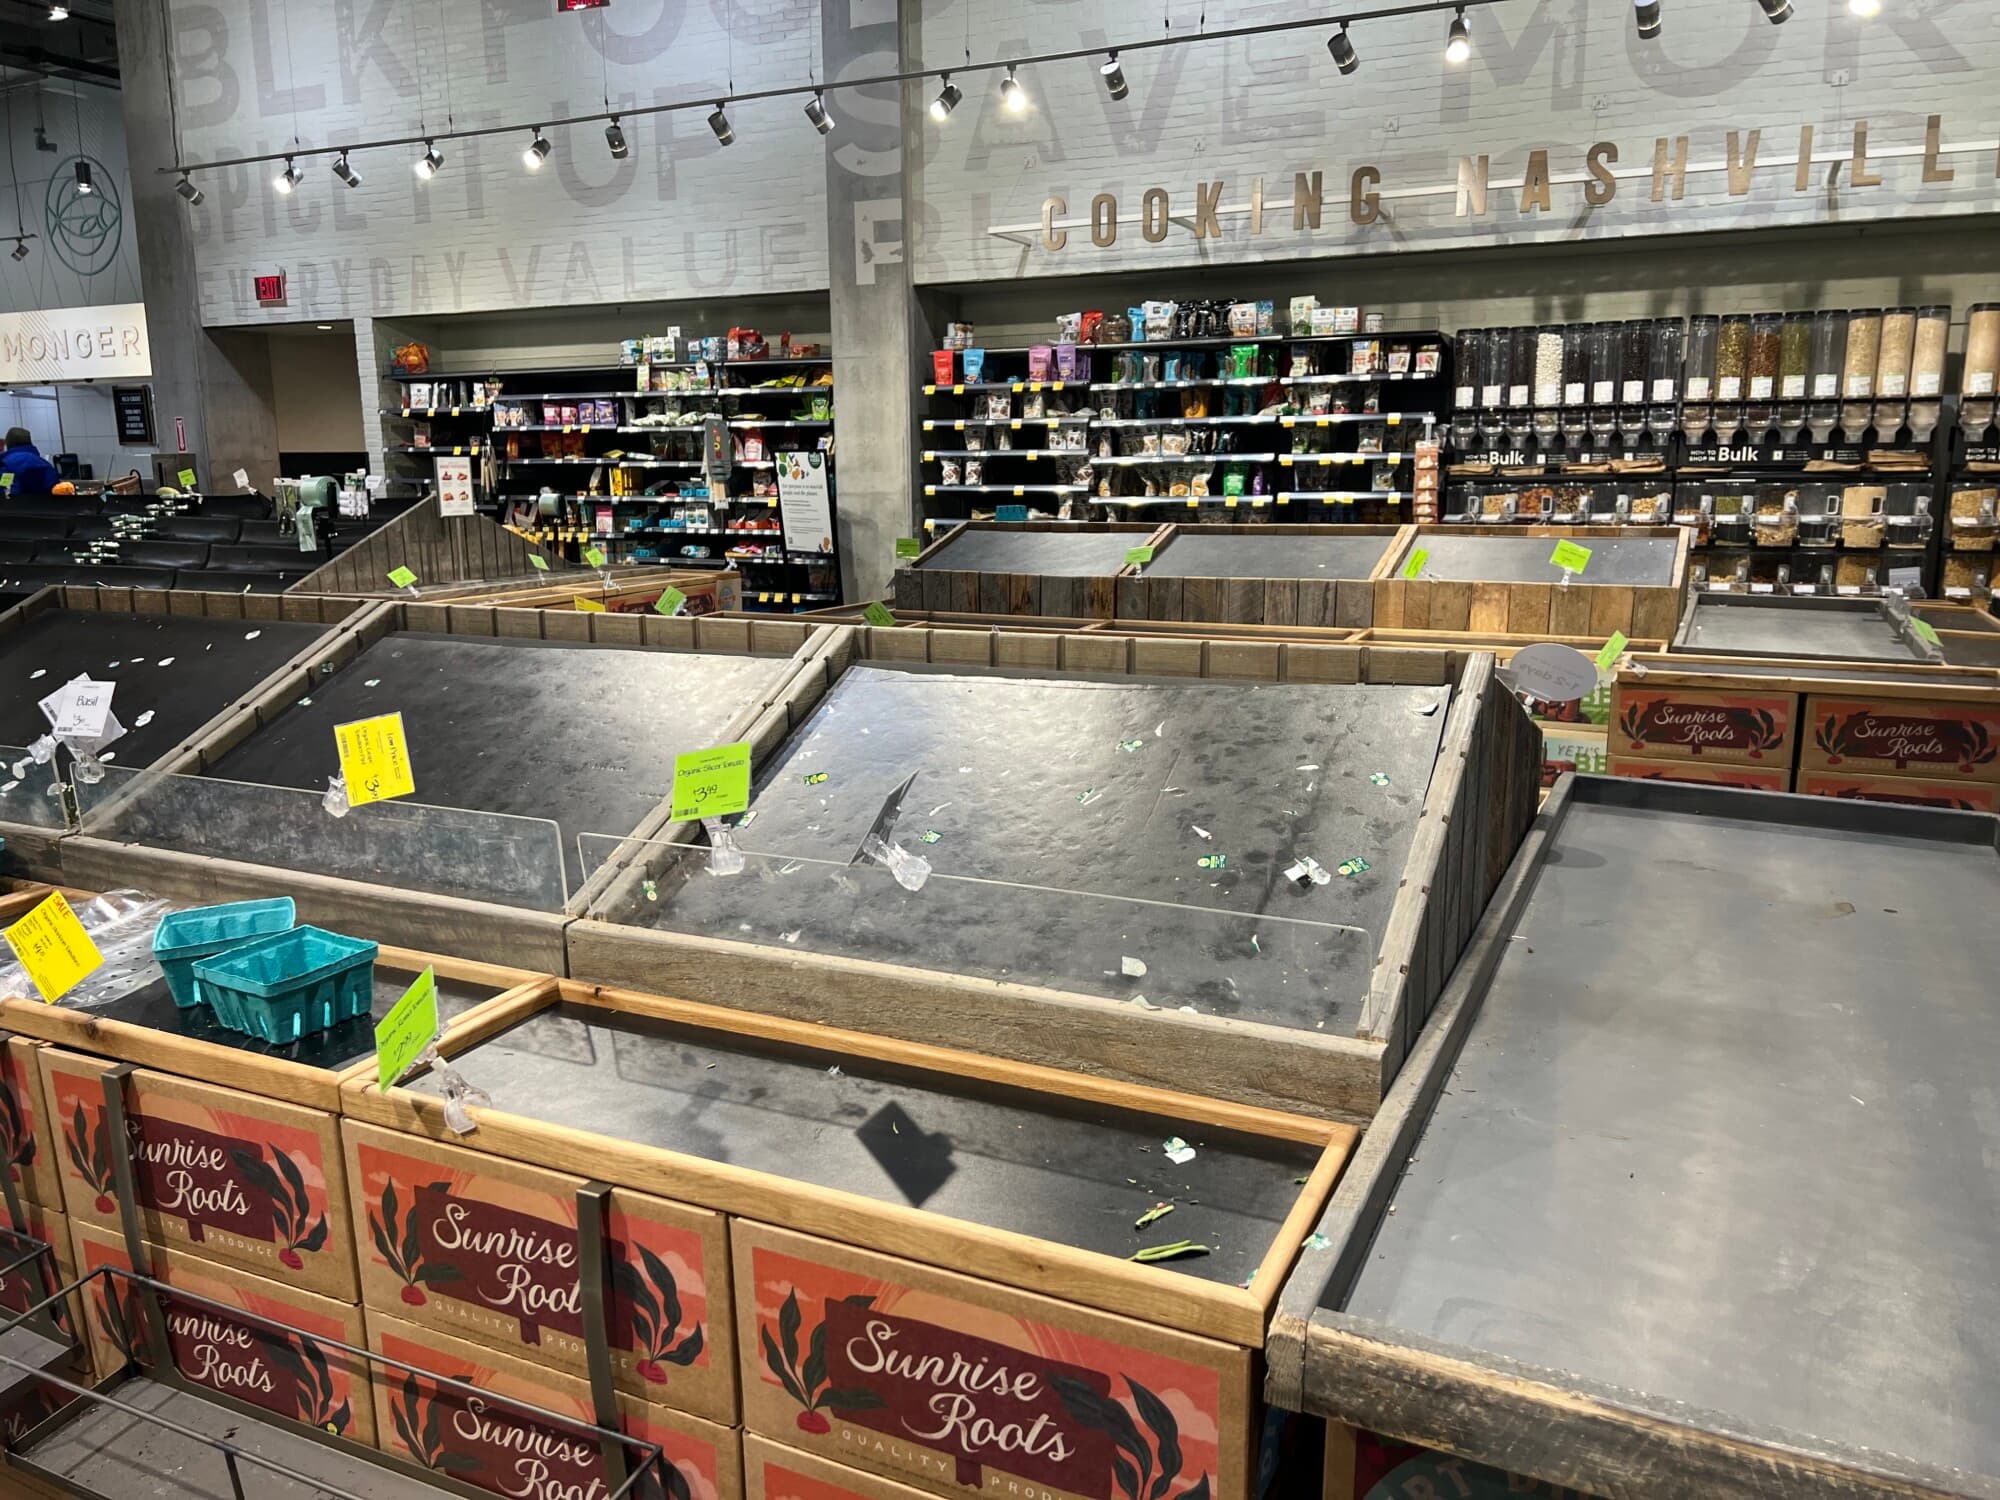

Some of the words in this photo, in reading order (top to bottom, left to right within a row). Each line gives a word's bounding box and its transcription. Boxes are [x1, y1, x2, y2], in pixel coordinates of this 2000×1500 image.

[552, 83, 738, 207] UP
[1041, 165, 1381, 252] COOKING
[1455, 113, 2000, 217] NASHVILL
[201, 251, 466, 325] EVRYDAY
[497, 222, 807, 304] VALUE
[259, 278, 281, 299] EXIT
[3, 325, 142, 362] MONGER
[1489, 451, 1524, 465] Bulk
[1718, 446, 1759, 462] Bulk
[76, 695, 99, 707] Basil
[1654, 706, 1727, 725] Sunrise
[1673, 724, 1735, 743] Roots
[1854, 718, 1936, 738] Sunrise
[1876, 737, 1943, 757] Roots
[52, 895, 72, 920] SALE
[155, 1170, 250, 1216] Roots
[208, 1232, 273, 1258] PRODUCE
[432, 1202, 577, 1269] Sunrise
[477, 1263, 582, 1315] Root
[435, 1299, 515, 1334] QUALITY
[184, 1343, 276, 1393] Roots
[845, 1318, 1045, 1402] Sunrise
[453, 1396, 596, 1469] Sunrise
[900, 1392, 1076, 1463] Roots
[841, 1429, 949, 1473] QUALITY
[991, 1476, 1063, 1500] PROD
